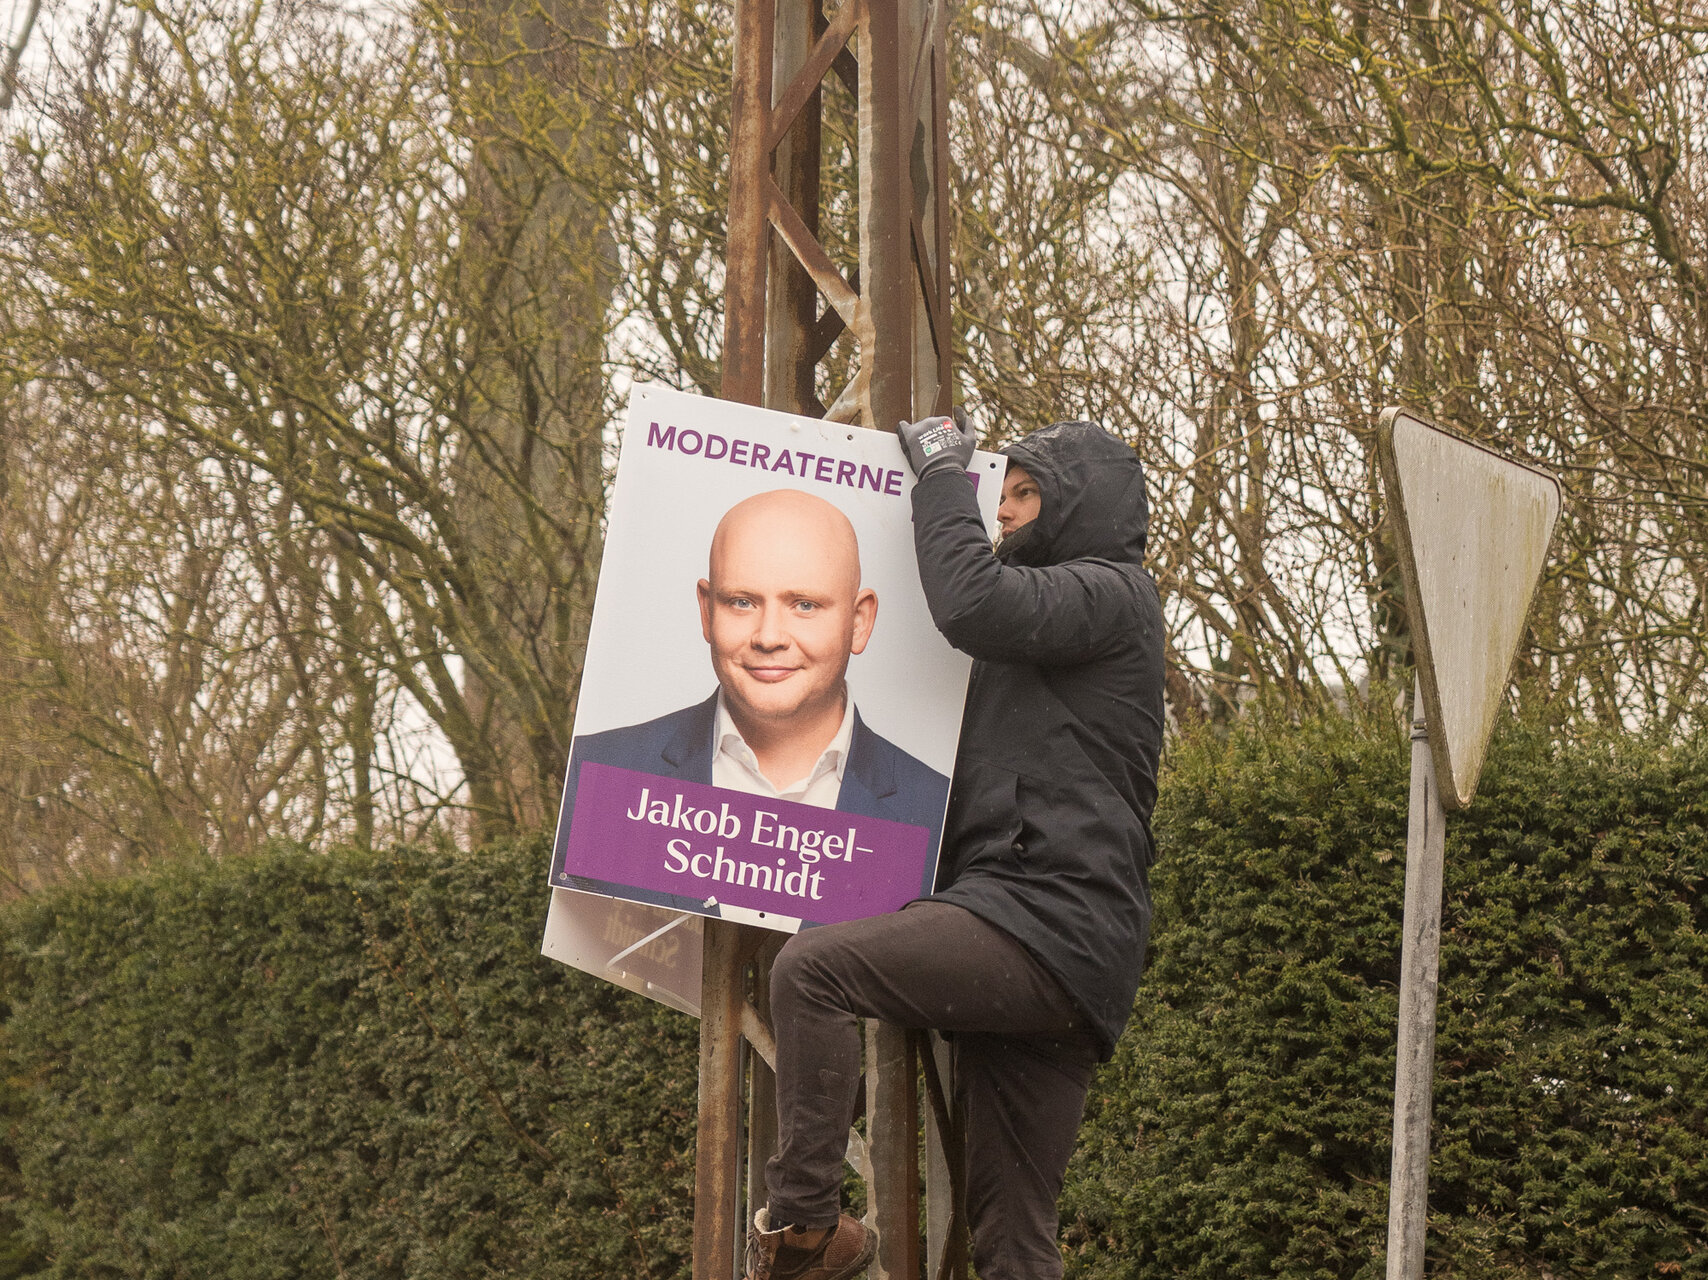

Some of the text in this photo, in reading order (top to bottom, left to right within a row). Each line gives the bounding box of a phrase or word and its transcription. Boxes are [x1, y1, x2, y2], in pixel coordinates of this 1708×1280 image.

[647, 421, 904, 496] MODERATERNE
[627, 788, 874, 863] Jakob Engel-
[663, 838, 826, 901] Schmidt
